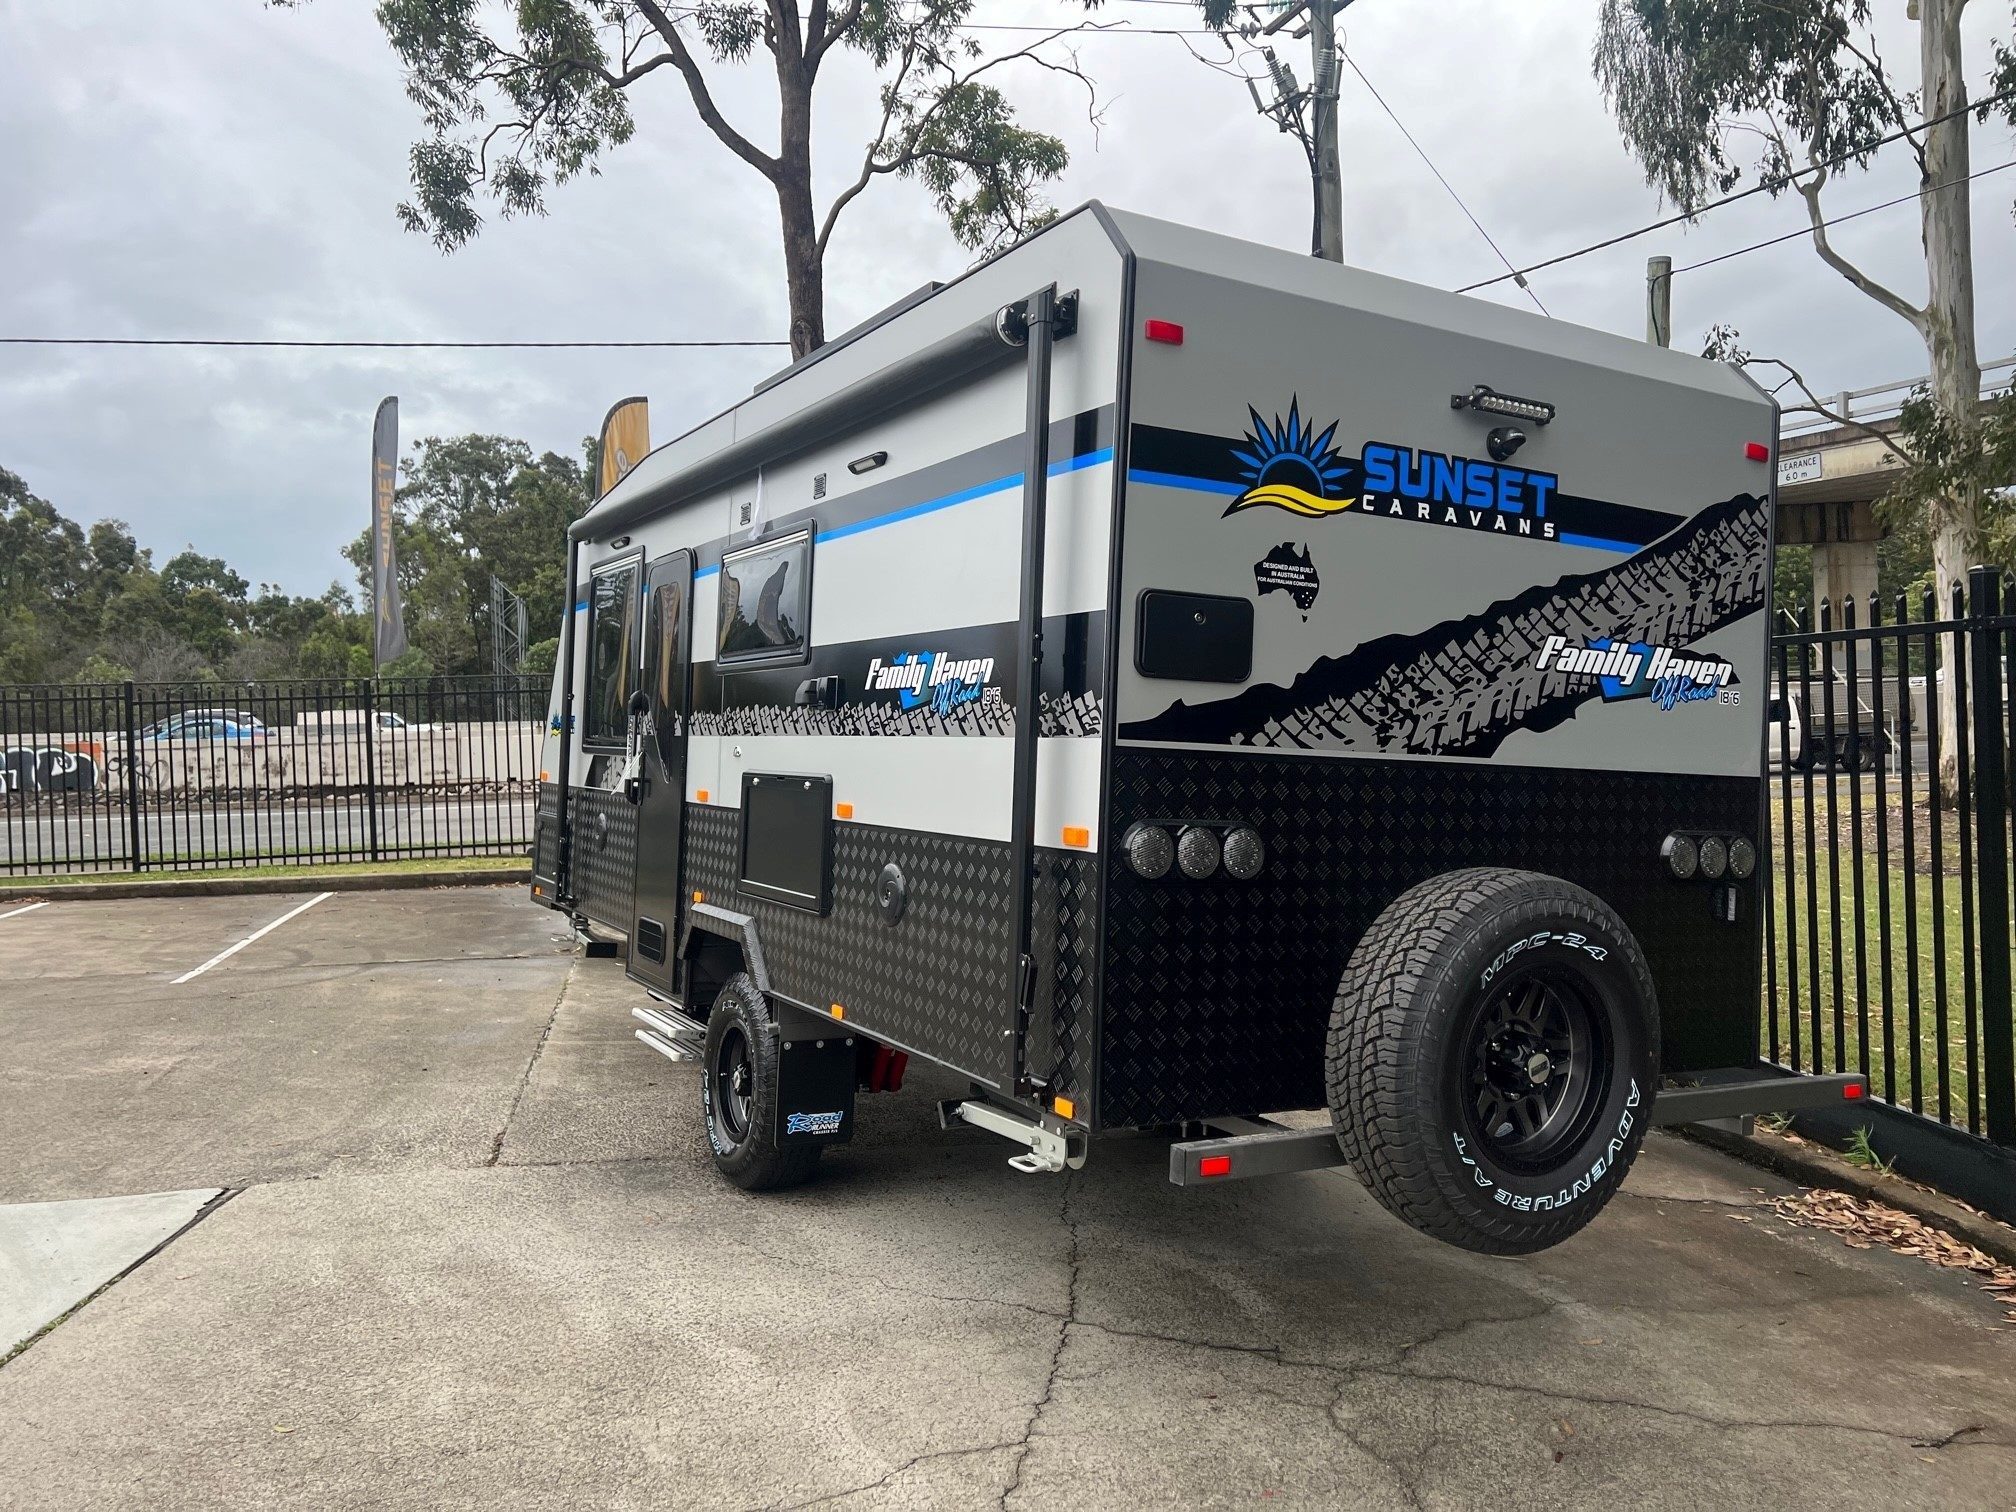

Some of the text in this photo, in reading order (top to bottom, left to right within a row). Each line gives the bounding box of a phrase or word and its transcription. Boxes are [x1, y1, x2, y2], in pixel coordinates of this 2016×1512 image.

[1363, 444, 1556, 518] SUNSET
[1779, 457, 1817, 472] LEARANCE
[1362, 494, 1555, 538] CARAVANS
[1262, 562, 1288, 571] DESIGNED
[1267, 577, 1292, 586] AUSTRALIAN
[1293, 580, 1318, 588] CONDITIONS
[1277, 571, 1305, 580] AUSTRALIA
[864, 651, 995, 696] Family Haven
[1535, 635, 1733, 686] Family Haven
[1480, 931, 1608, 990] MPC-24
[787, 1111, 844, 1135] Road
[811, 1122, 840, 1131] RUNNER
[1494, 1077, 1641, 1212] ADVENTURE
[1453, 1132, 1494, 1187] A/T
